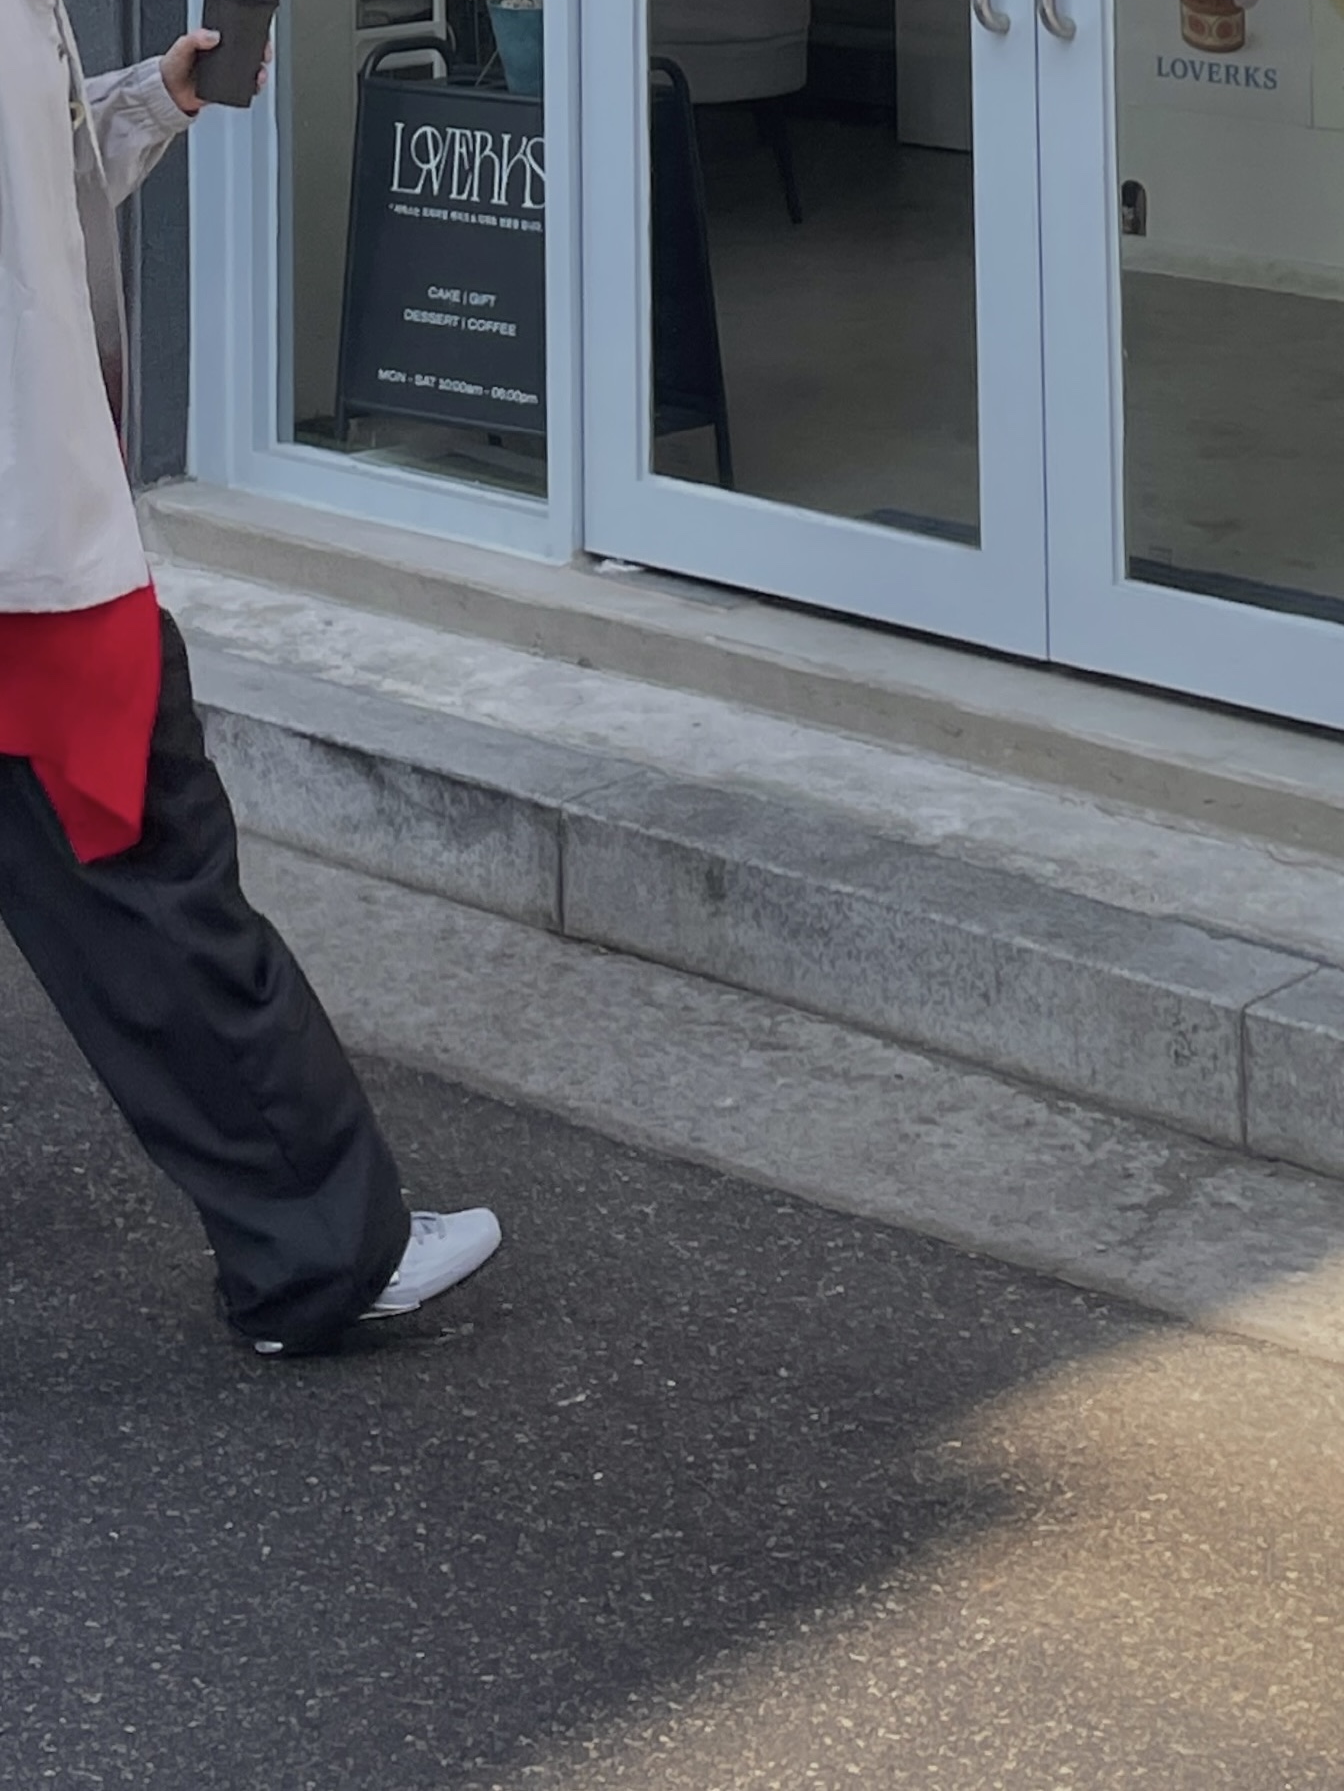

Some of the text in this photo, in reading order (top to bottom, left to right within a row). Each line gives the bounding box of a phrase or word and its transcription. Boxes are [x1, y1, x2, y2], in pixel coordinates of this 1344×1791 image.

[1156, 55, 1278, 90] LOVERKS
[427, 286, 461, 303] CAKE
[469, 292, 497, 308] GIFT
[403, 308, 460, 328] DESSERT
[467, 317, 517, 337] COFFEE
